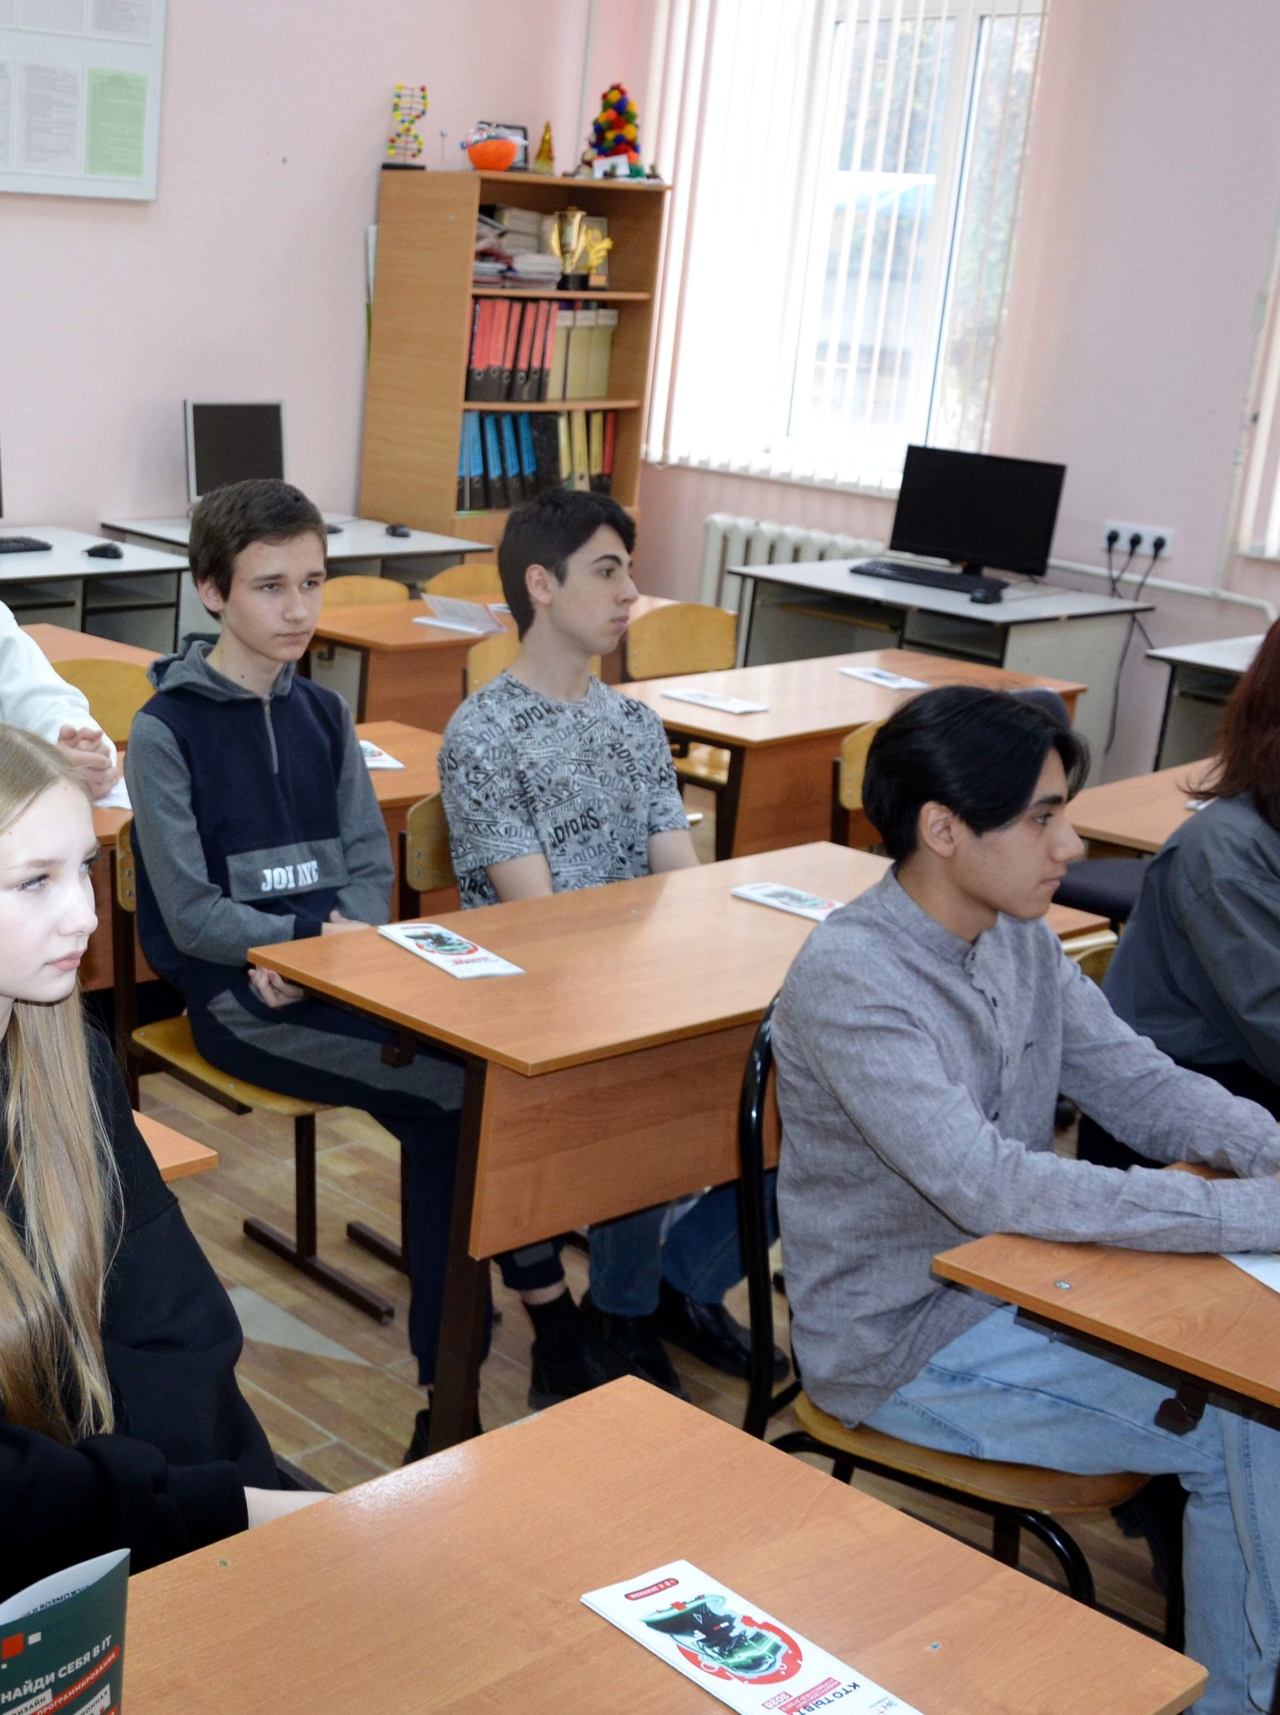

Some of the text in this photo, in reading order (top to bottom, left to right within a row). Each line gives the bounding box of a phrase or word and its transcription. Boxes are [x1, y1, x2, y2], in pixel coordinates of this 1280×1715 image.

[0, 1634, 113, 1705] НАЙДИ СЕБЯ В IT
[36, 1652, 117, 1715] ПРОГРАММИРОВАНИЕ
[832, 1681, 861, 1699] КТО
